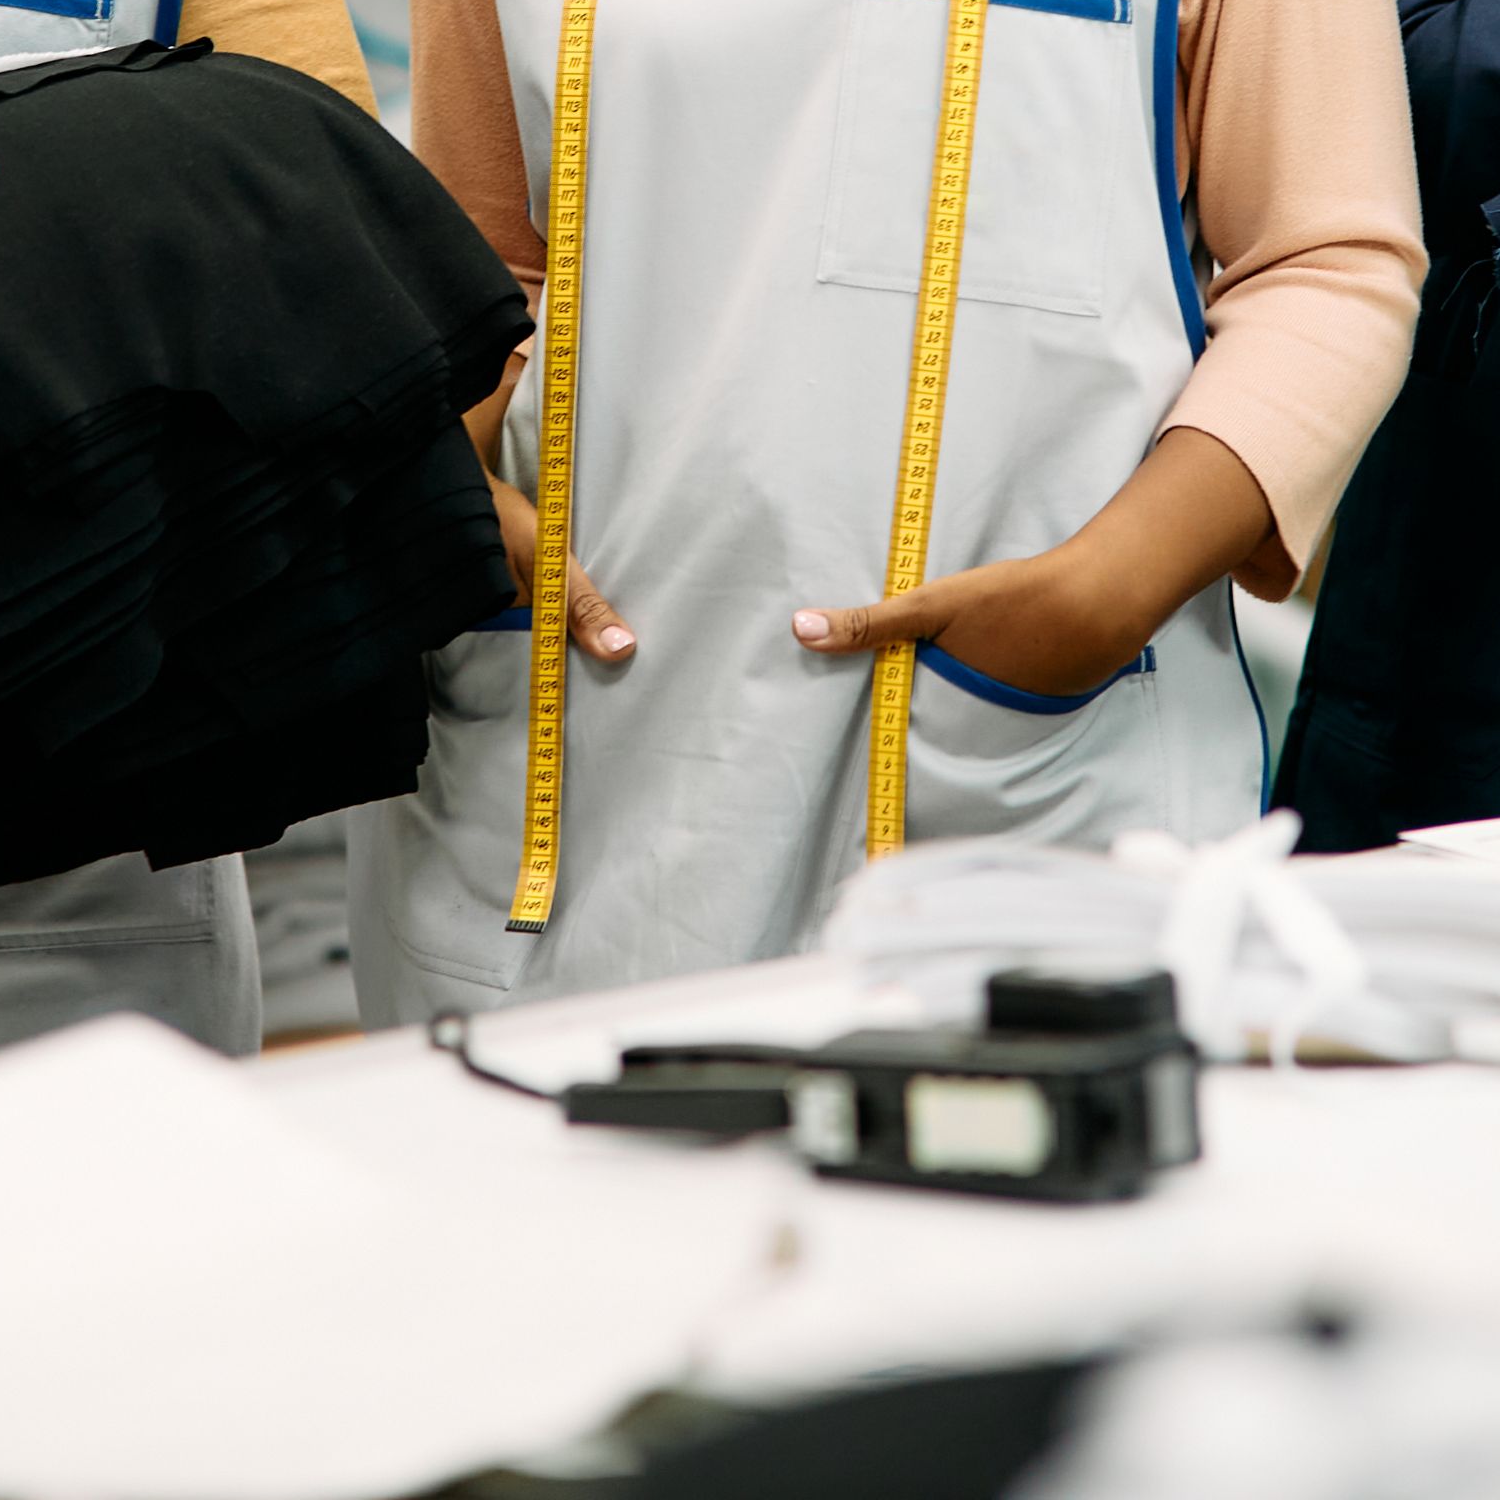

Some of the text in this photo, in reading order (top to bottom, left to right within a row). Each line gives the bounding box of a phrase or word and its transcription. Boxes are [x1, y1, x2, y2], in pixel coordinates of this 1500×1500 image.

[948, 130, 964, 141] 37
[945, 152, 961, 163] 36
[943, 175, 959, 187] 35
[941, 197, 956, 209] 34
[937, 219, 954, 231] 33
[935, 242, 951, 254] 32
[934, 264, 947, 276] 31
[931, 287, 947, 298] 30
[929, 310, 944, 322] 29
[923, 354, 939, 366] 27
[921, 376, 936, 388] 26
[918, 398, 933, 410] 25
[915, 422, 930, 433] 24
[912, 443, 929, 456] 23
[911, 466, 926, 479] 22
[909, 488, 922, 500] 21
[904, 511, 918, 522] 20
[902, 534, 915, 546] 19
[899, 557, 912, 568] 18
[896, 578, 910, 590] 17
[888, 644, 901, 656] 14
[886, 667, 899, 679] 13
[884, 690, 897, 702] 12
[885, 713, 894, 725] 11
[883, 735, 894, 747] 10
[885, 757, 892, 769] 9
[882, 803, 890, 814] 7
[883, 825, 890, 836] 6
